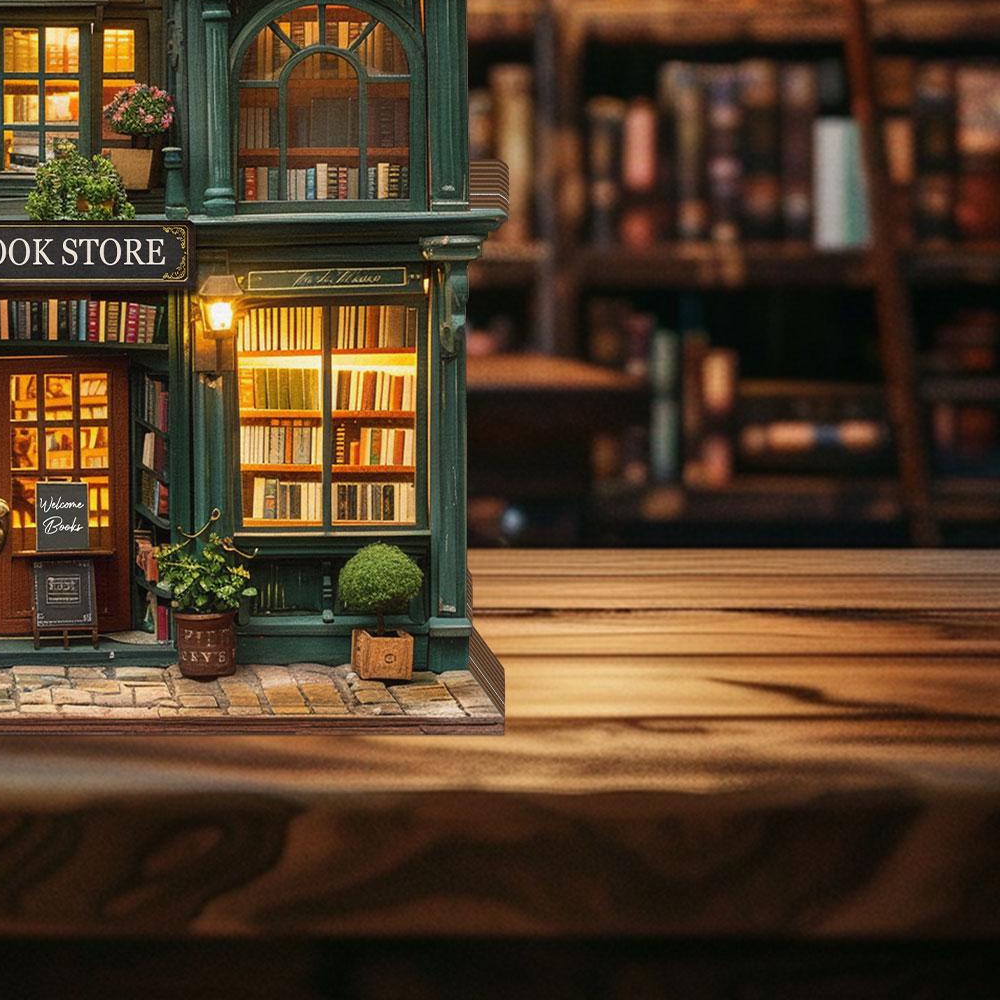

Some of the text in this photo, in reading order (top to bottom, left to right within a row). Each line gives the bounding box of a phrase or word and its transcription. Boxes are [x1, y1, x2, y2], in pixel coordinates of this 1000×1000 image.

[61, 238, 166, 266] STORE
[40, 496, 84, 513] Welcome
[43, 516, 84, 534] Books
